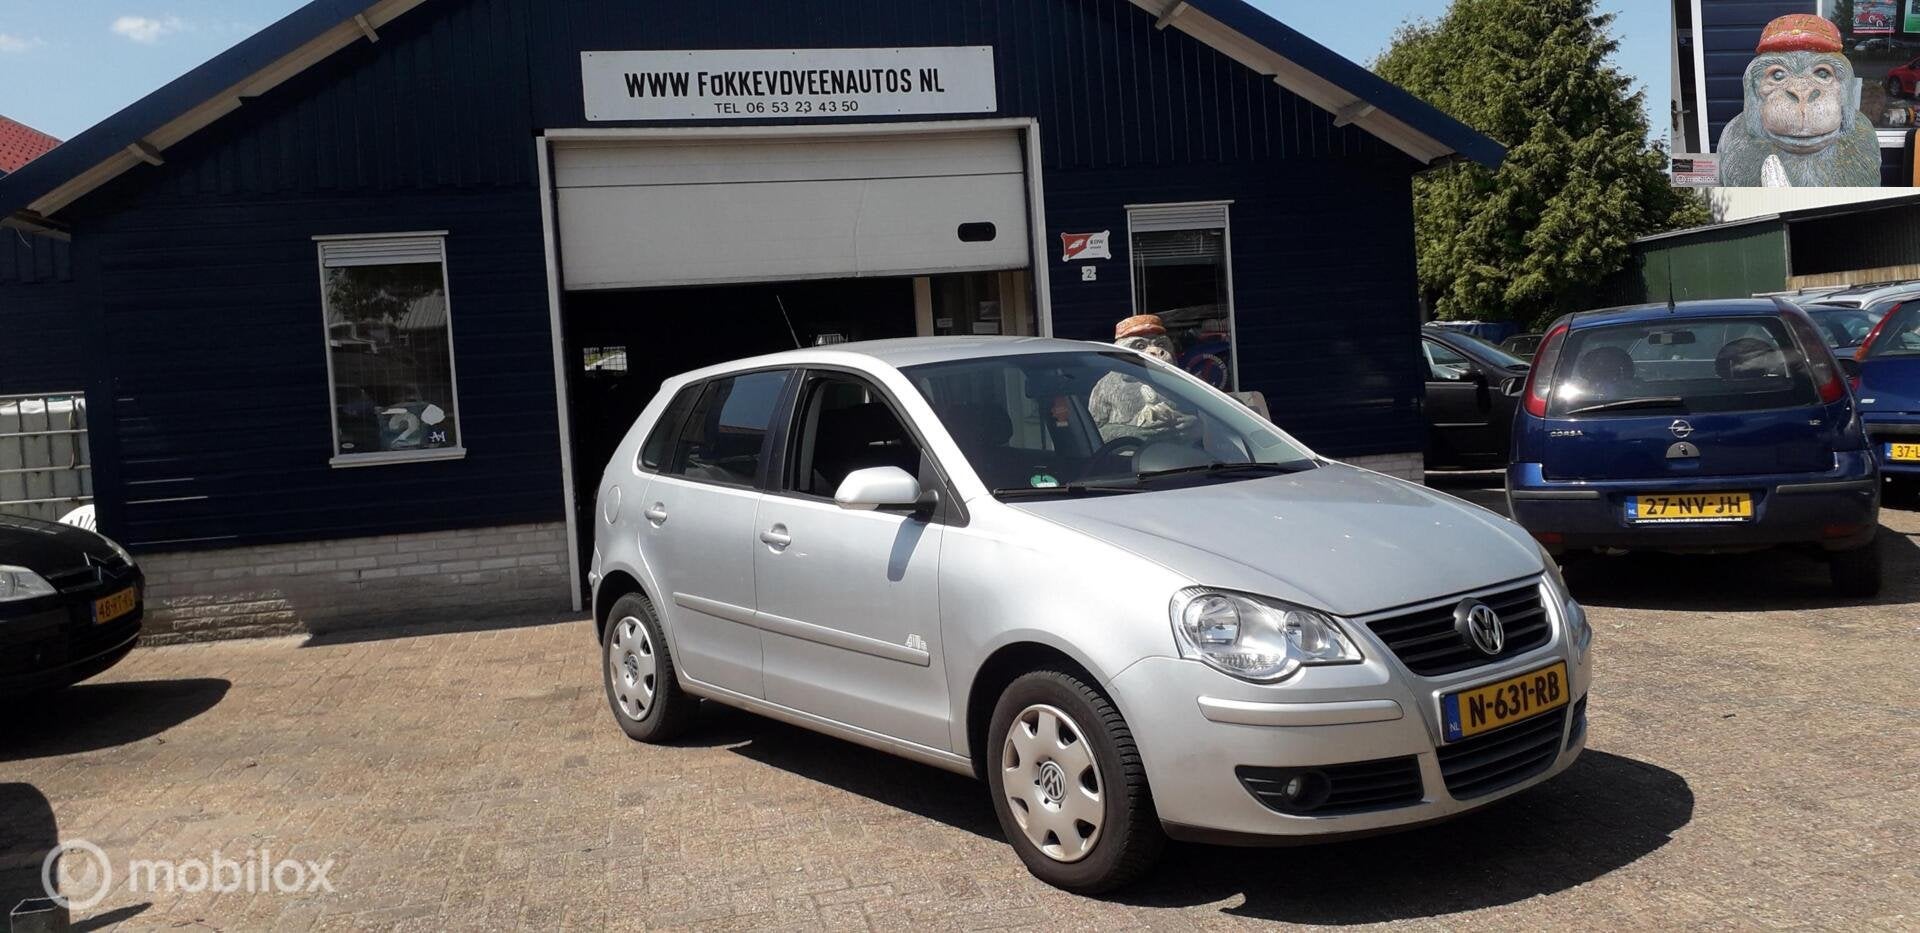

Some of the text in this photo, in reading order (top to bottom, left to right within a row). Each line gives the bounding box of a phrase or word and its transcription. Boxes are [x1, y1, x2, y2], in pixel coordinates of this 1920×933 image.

[624, 71, 690, 98] WWW
[919, 68, 945, 93] NL
[714, 100, 859, 114] TEL 06 53 23 43 50
[1086, 268, 1093, 279] 2
[1645, 496, 1741, 515] 27-NV-JH
[1468, 671, 1561, 728] N-631-RB
[1449, 722, 1460, 733] NL
